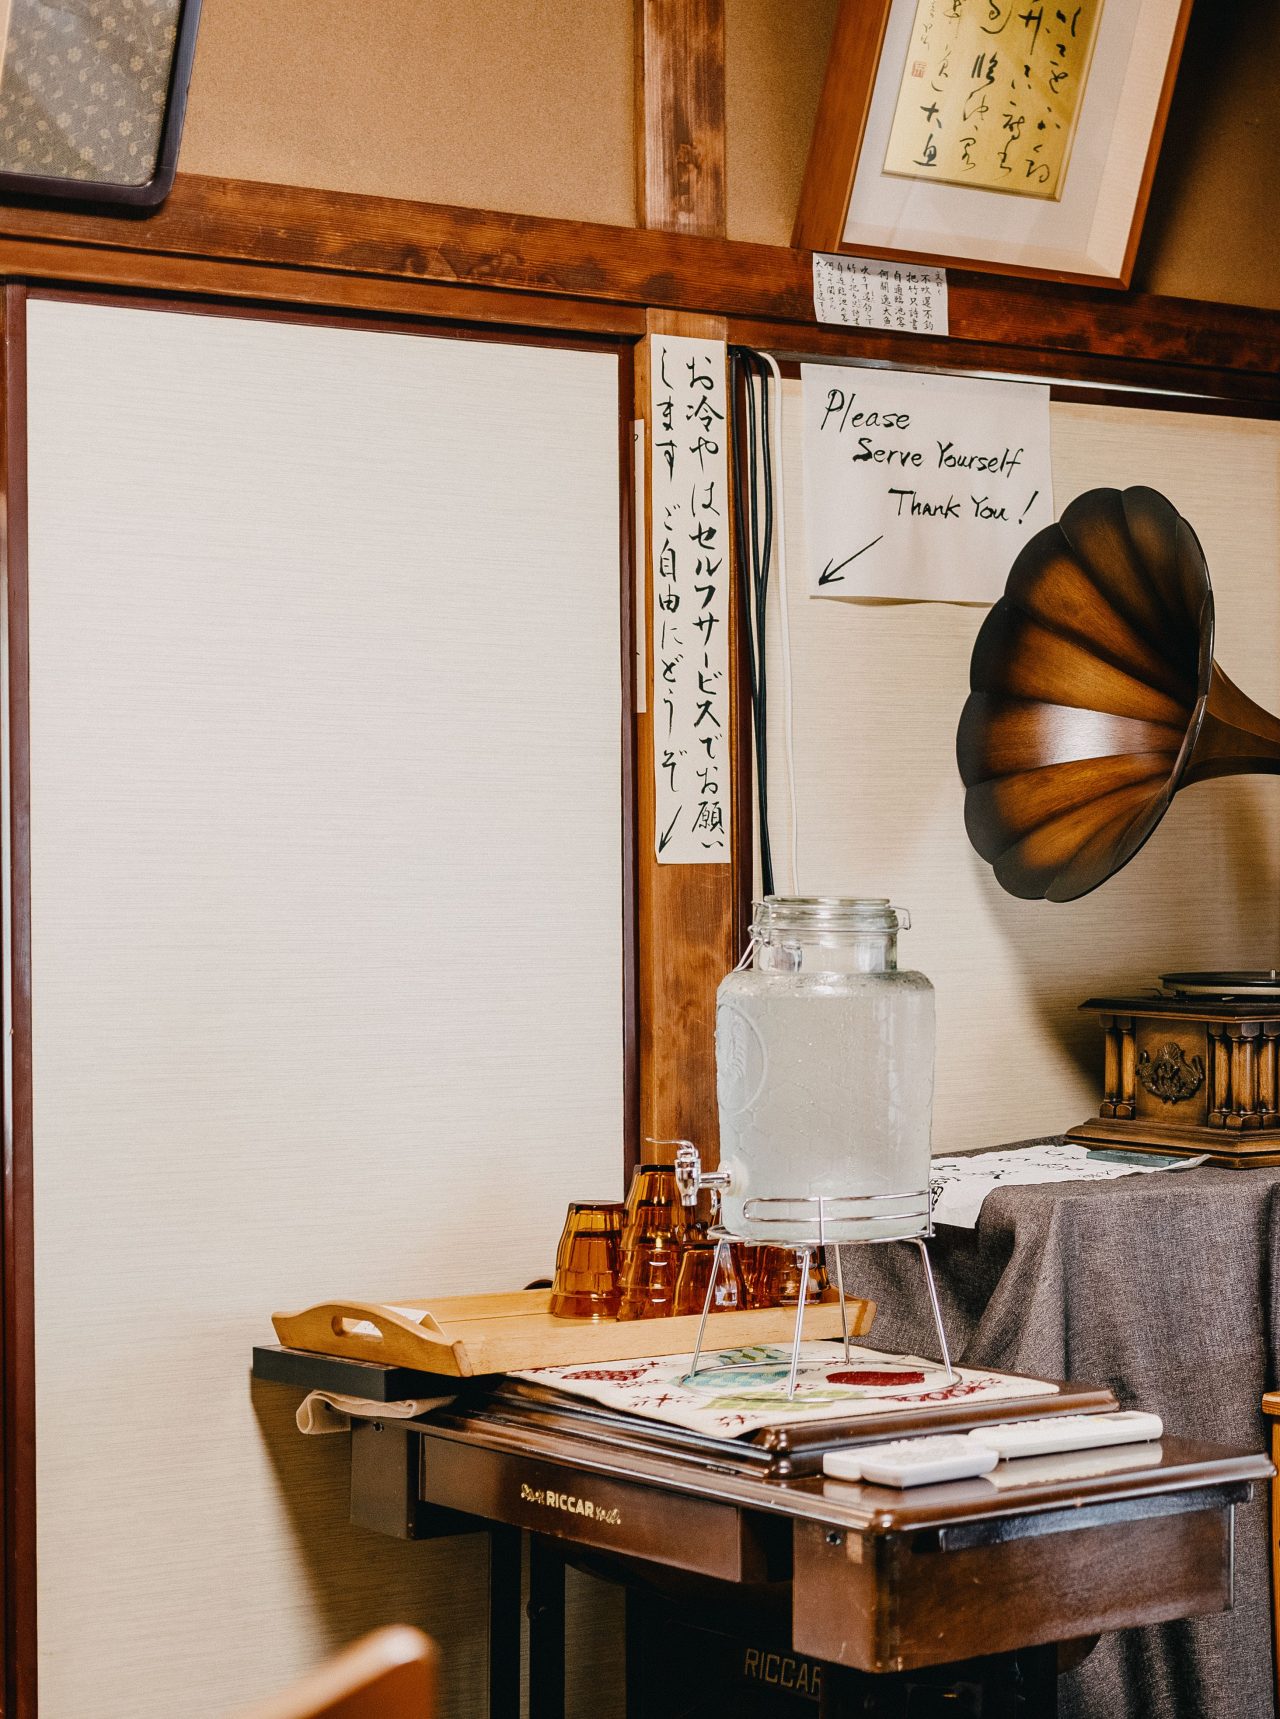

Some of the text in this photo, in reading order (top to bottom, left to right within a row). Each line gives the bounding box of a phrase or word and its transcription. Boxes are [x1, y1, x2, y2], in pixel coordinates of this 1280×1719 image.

[820, 389, 911, 432] Please
[852, 437, 1025, 478] Serve Yourself
[888, 488, 961, 518] Thank
[546, 1490, 594, 1518] RICCAR
